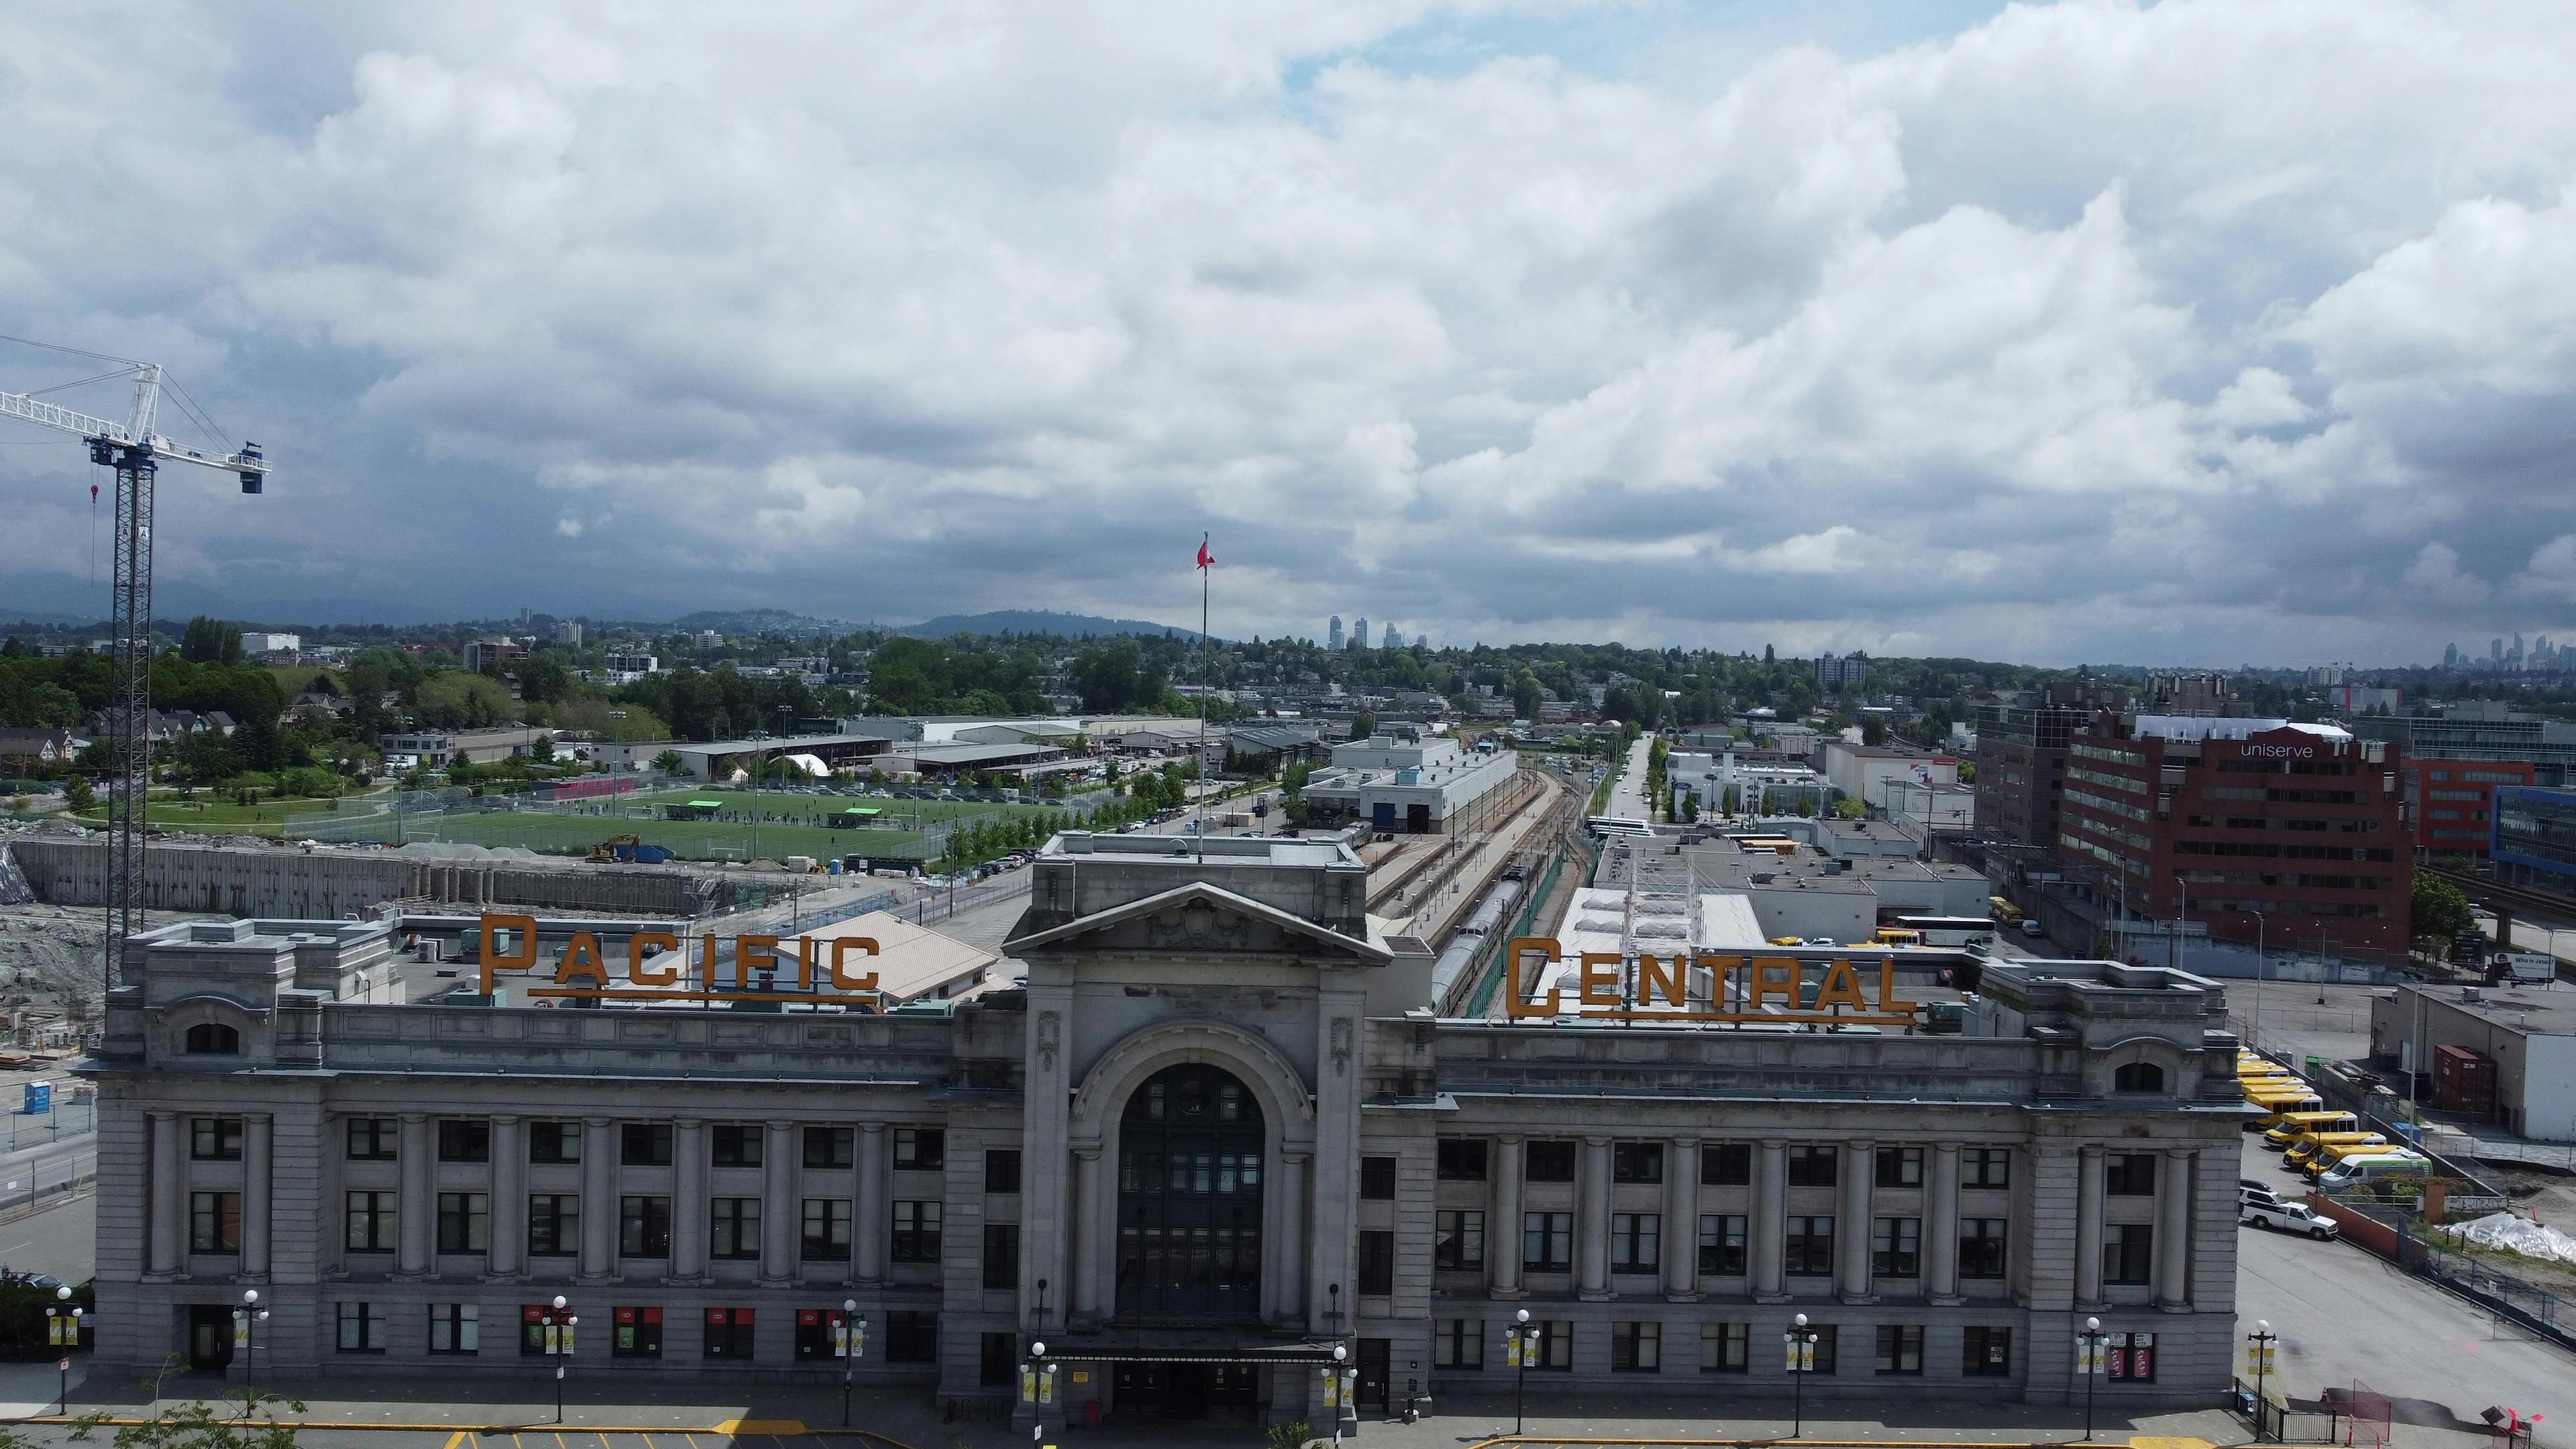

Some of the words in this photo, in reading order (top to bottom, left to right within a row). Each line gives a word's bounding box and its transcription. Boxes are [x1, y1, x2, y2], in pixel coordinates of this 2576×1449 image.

[2241, 743, 2313, 758] uniserve
[480, 914, 880, 996] PACIFIC
[1506, 937, 1917, 1017] CENTRAL
